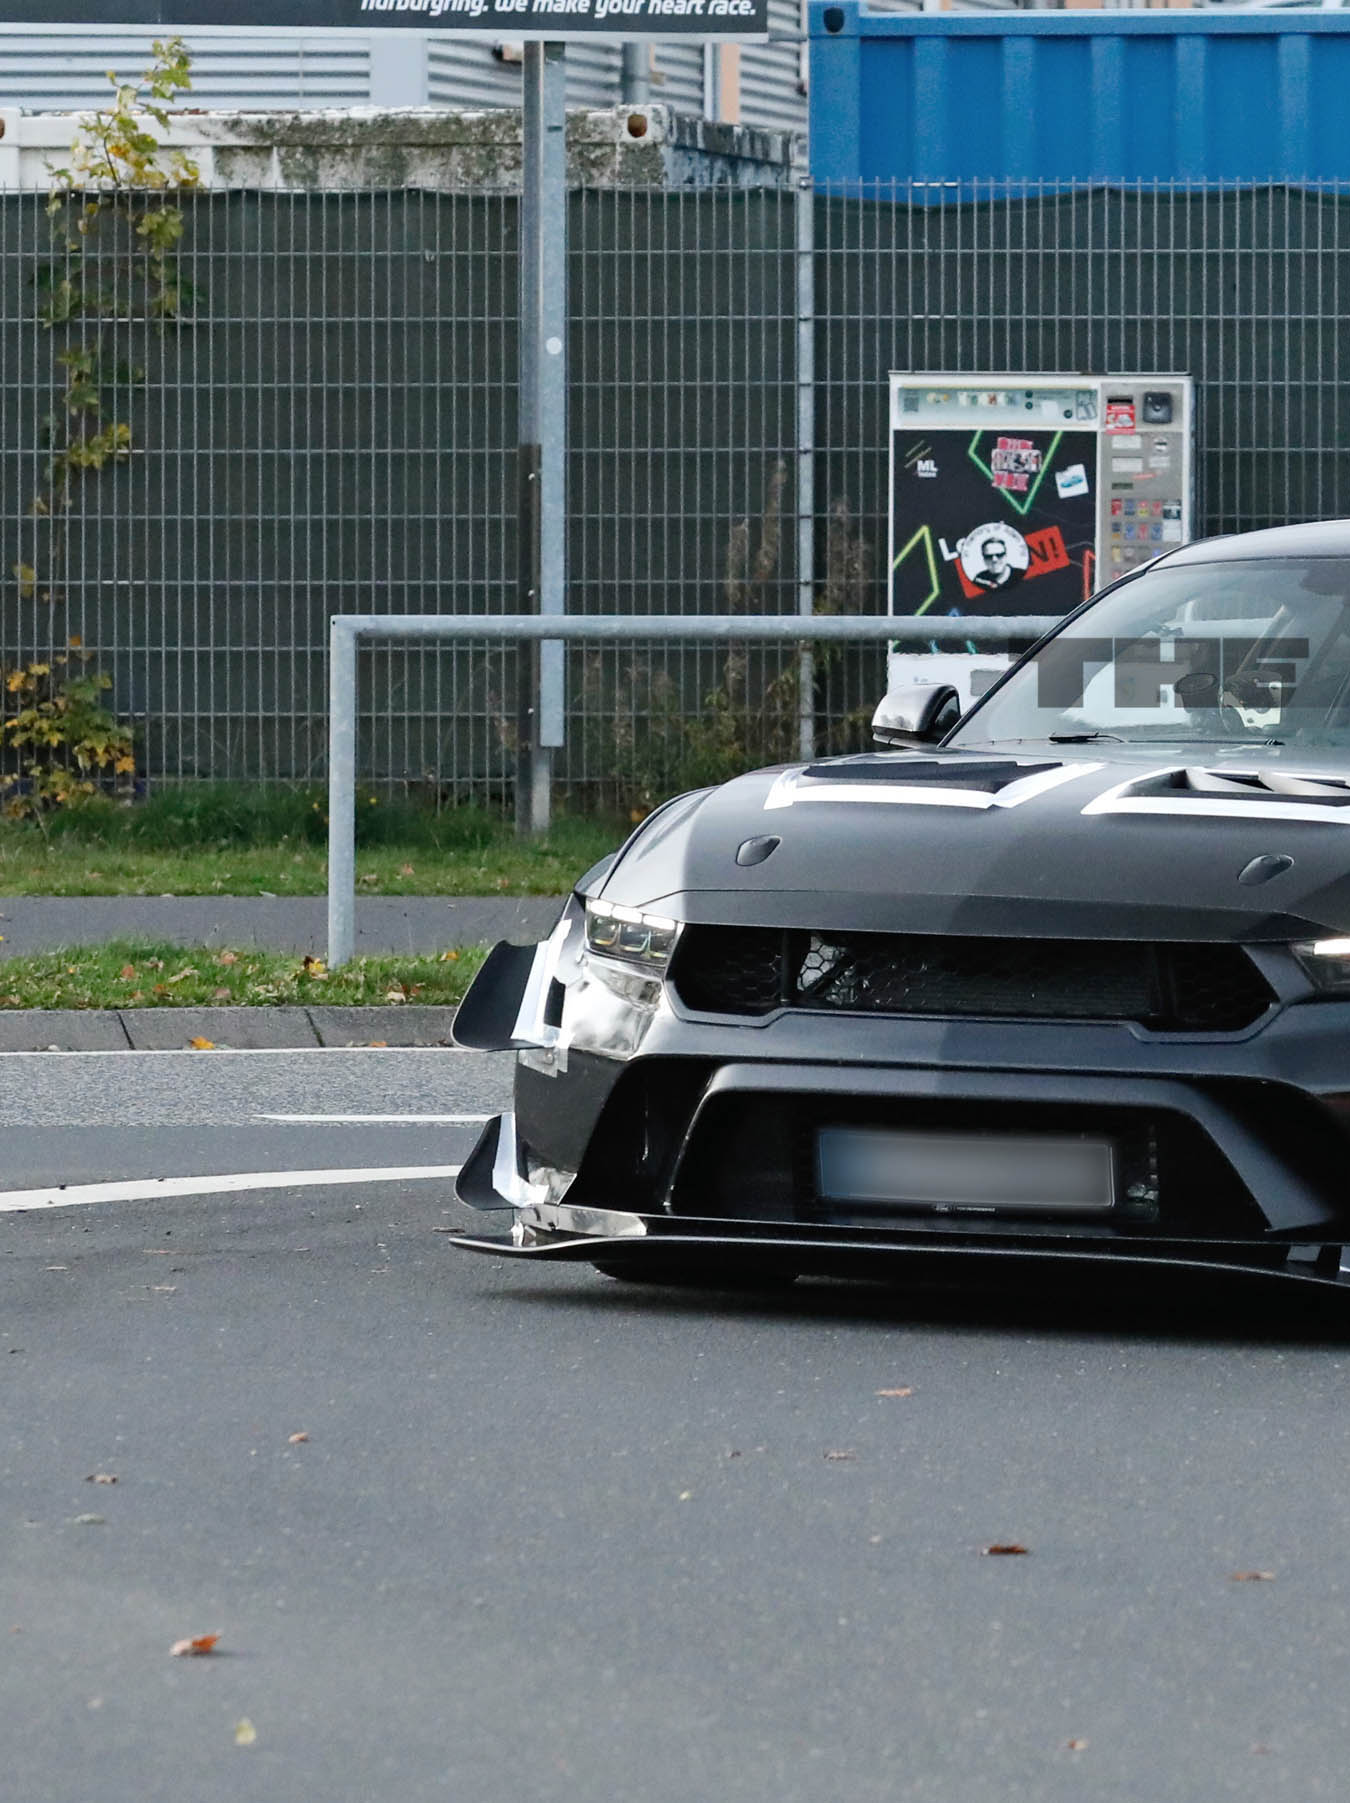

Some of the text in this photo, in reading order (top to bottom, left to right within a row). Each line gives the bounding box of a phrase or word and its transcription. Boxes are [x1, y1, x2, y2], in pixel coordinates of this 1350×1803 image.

[532, 0, 589, 14] make
[594, 0, 645, 18] your
[648, 0, 703, 15] heart
[707, 0, 756, 15] race.
